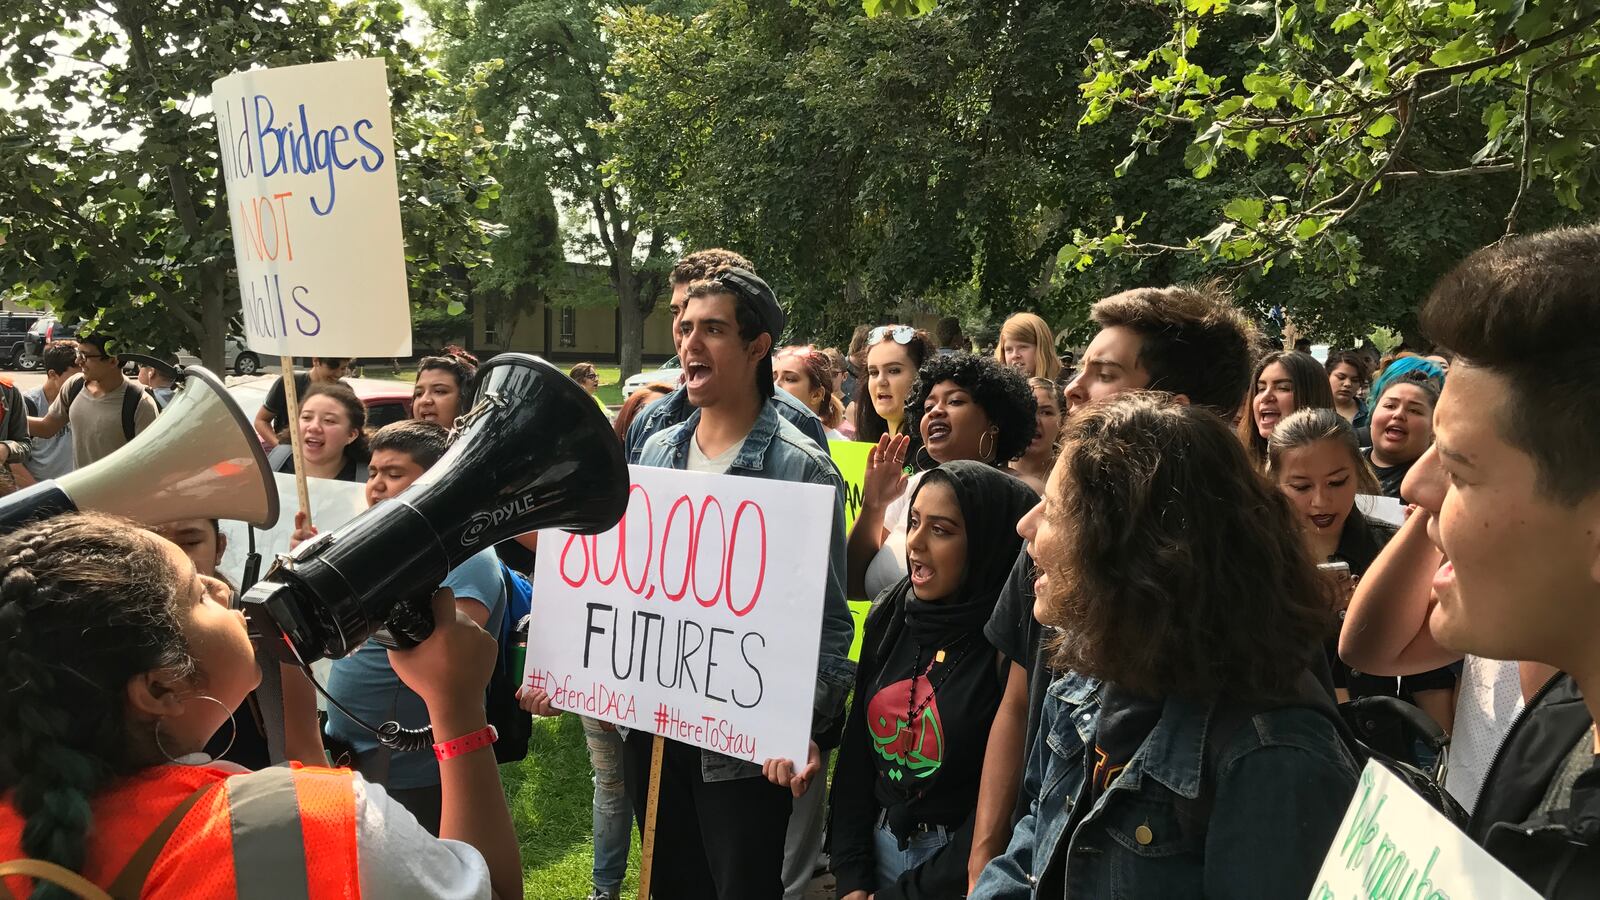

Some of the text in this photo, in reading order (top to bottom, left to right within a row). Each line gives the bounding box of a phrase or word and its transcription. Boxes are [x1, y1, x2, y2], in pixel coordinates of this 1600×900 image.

[254, 95, 384, 216] Bridges
[240, 191, 293, 262] NOT
[491, 494, 535, 526] PYLE
[583, 602, 766, 709] FUTURES
[527, 668, 756, 762] #DefendDACA #HereToStay
